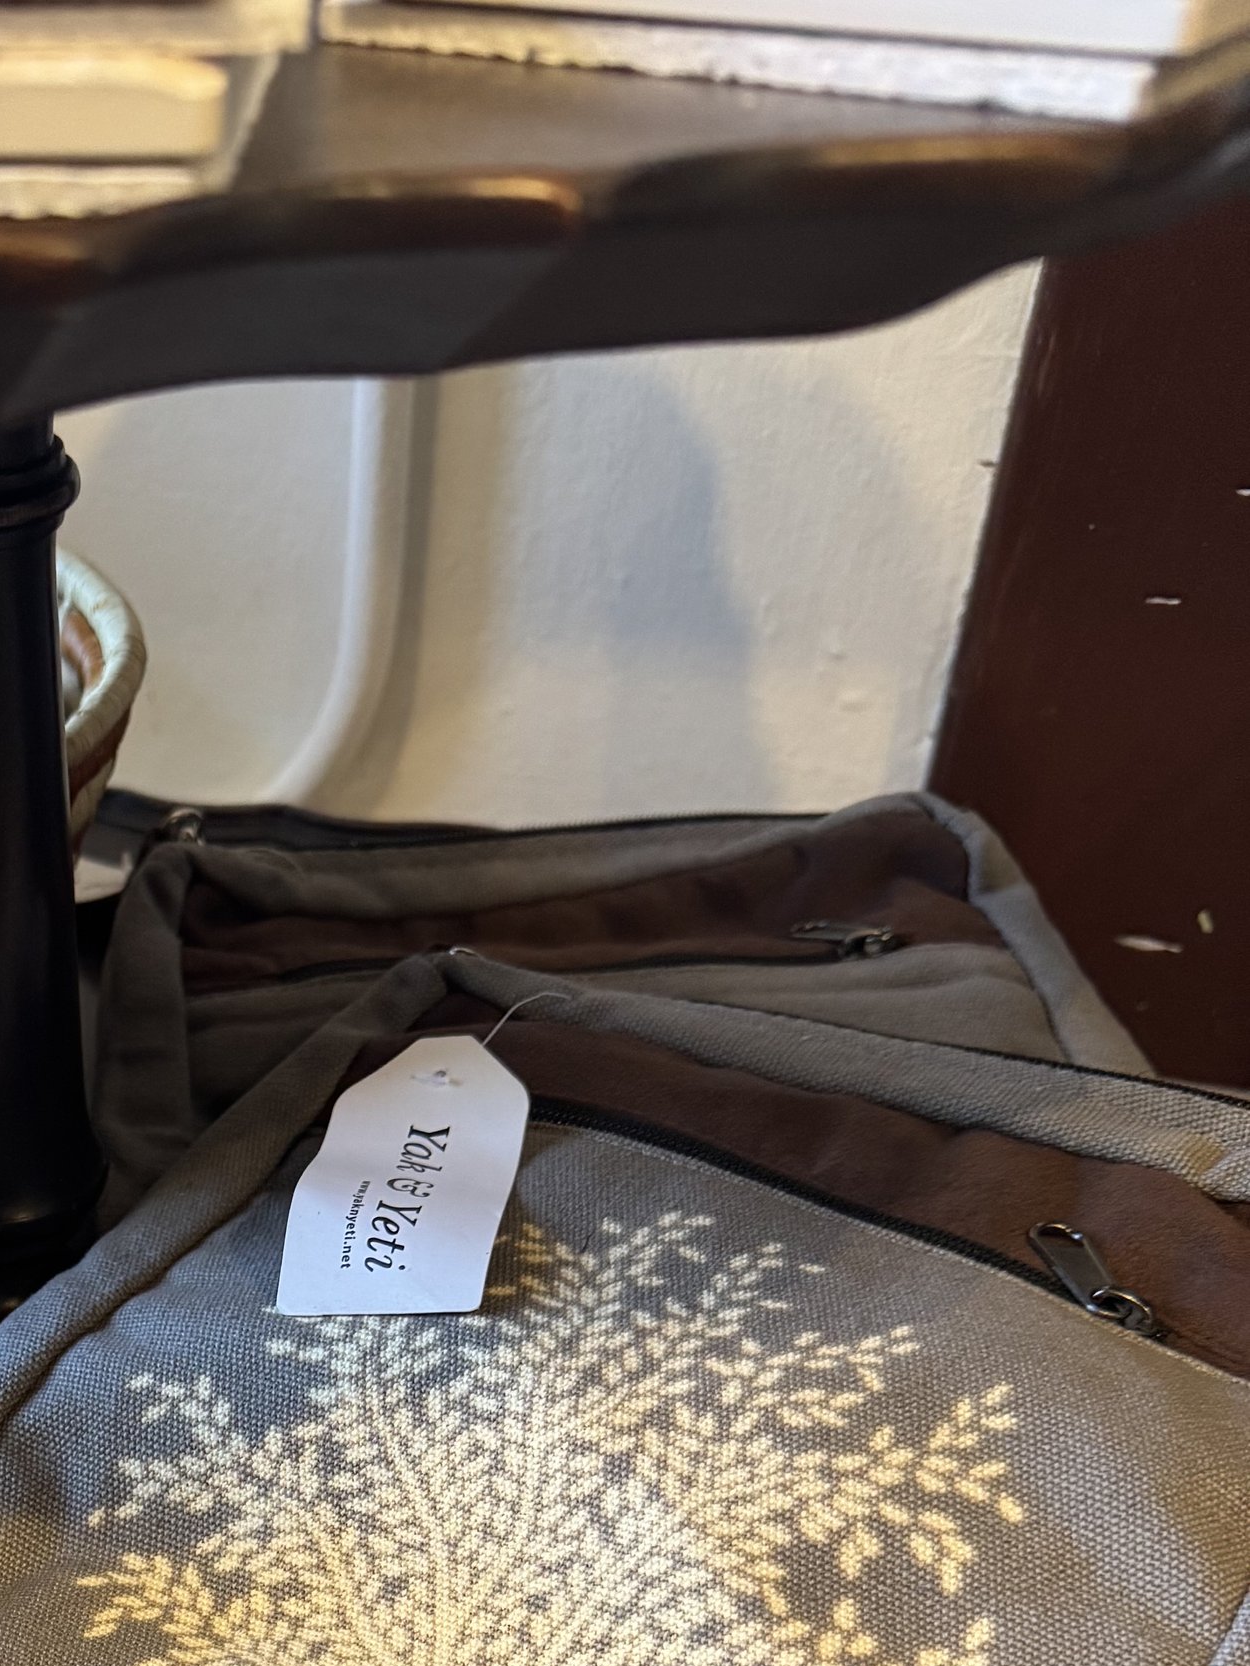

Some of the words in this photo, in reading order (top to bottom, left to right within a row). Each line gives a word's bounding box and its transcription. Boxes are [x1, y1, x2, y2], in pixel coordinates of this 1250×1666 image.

[395, 1124, 451, 1173] Yak
[386, 1177, 431, 1199] &
[340, 1180, 371, 1270] www.yaknyeti.net
[364, 1199, 423, 1273] Yeti
